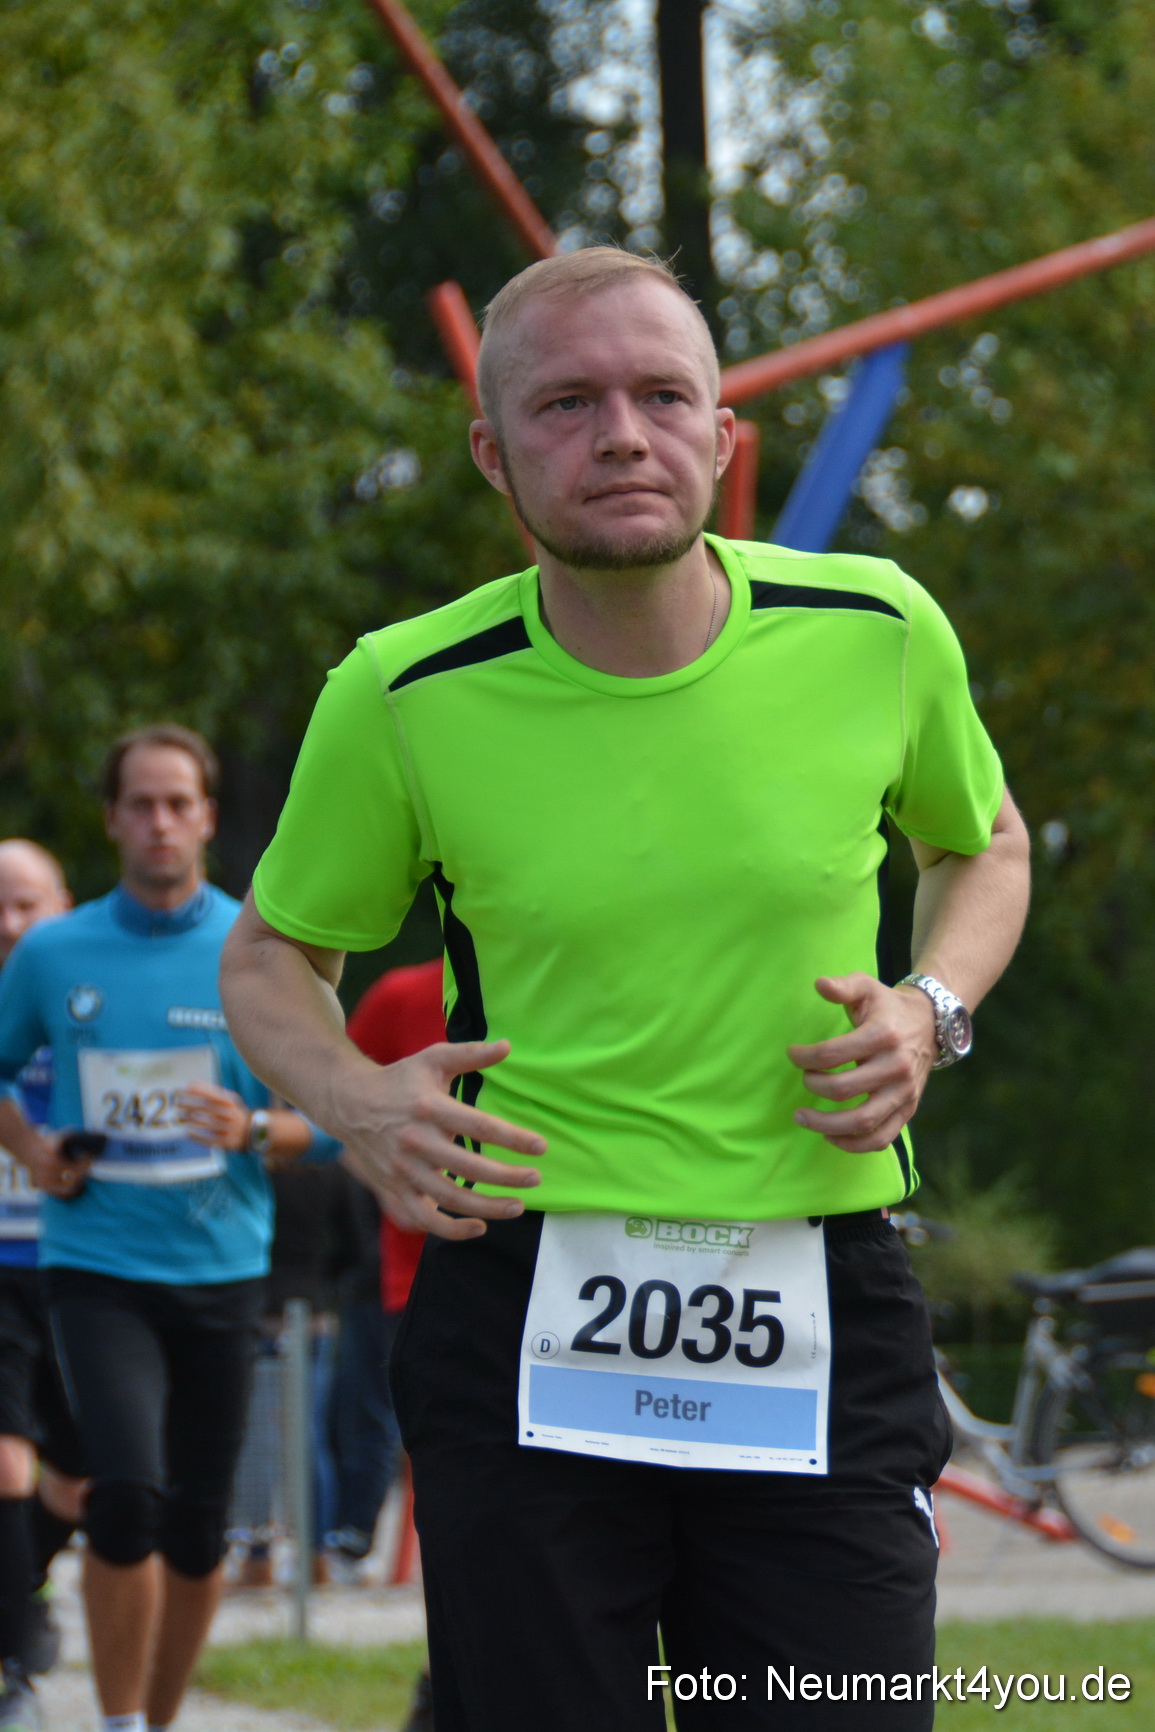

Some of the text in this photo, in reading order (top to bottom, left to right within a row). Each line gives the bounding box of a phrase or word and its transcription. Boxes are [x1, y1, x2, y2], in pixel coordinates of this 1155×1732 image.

[654, 1219, 755, 1248] BOCK
[653, 1242, 686, 1252] inspired
[686, 1244, 697, 1254] by
[698, 1246, 721, 1255] smart
[570, 1275, 785, 1368] 2035
[540, 1339, 551, 1353] D
[635, 1389, 712, 1422] Peter
